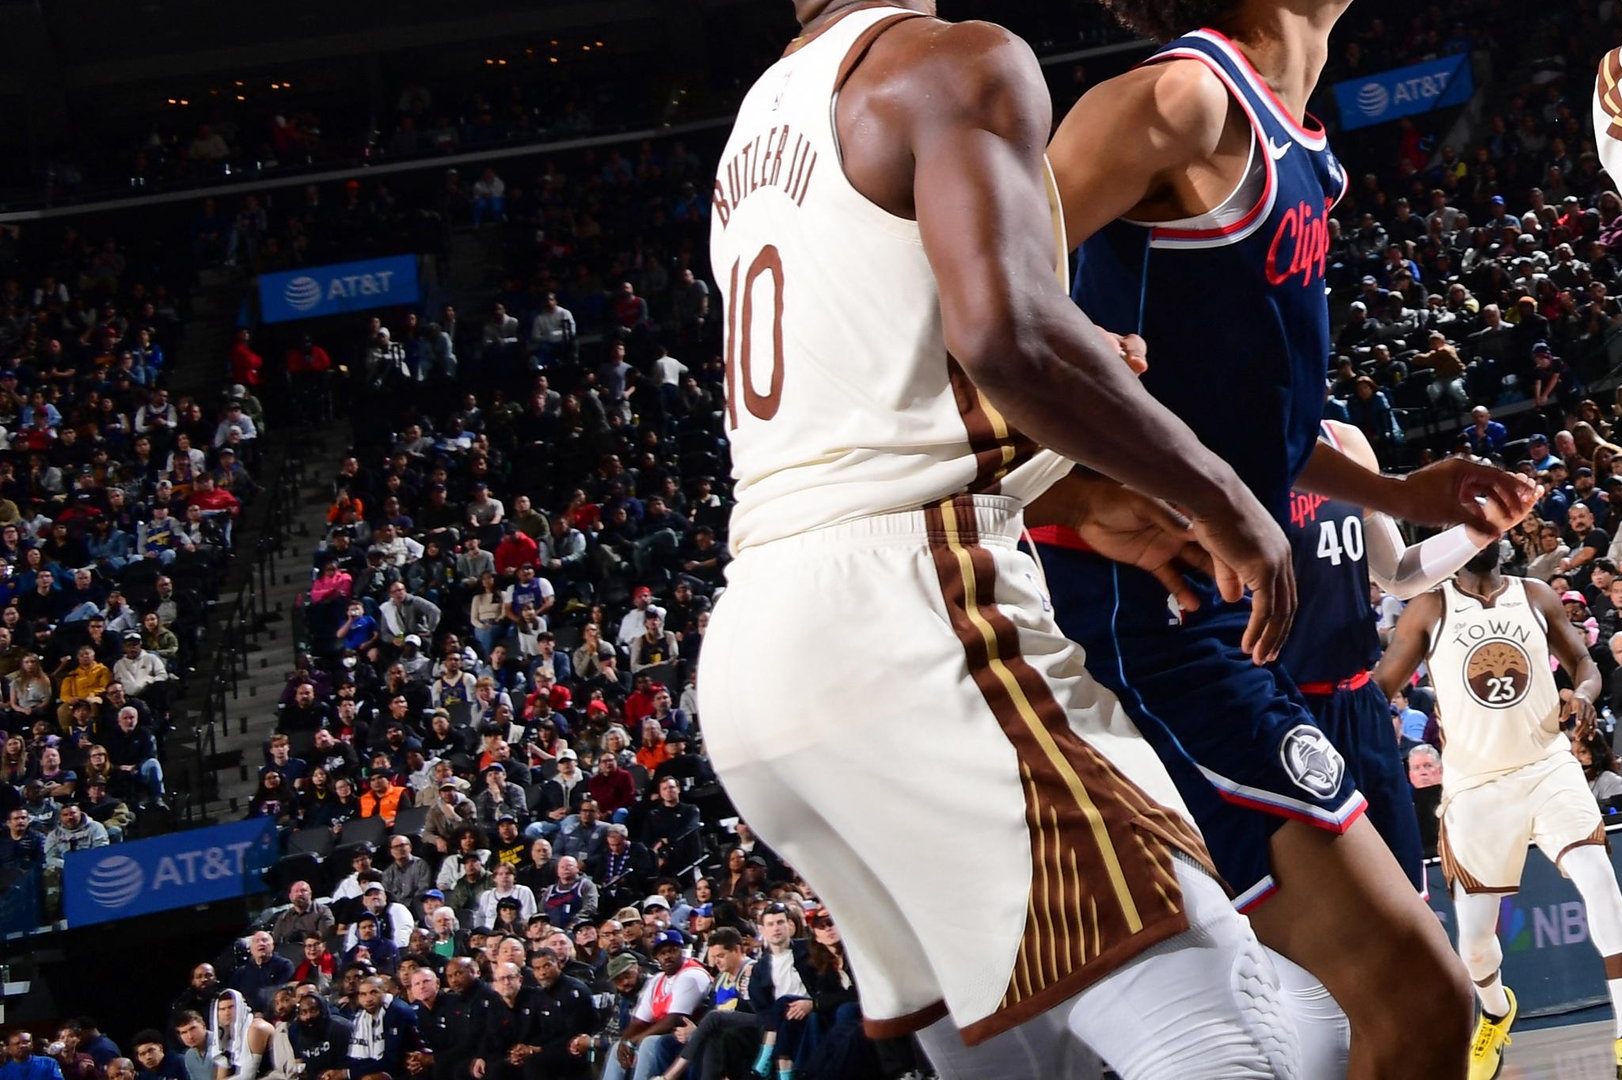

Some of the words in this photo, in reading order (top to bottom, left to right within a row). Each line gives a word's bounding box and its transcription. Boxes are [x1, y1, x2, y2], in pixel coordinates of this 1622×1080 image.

[1393, 69, 1452, 105] AT&T
[713, 123, 790, 232] BUTLER
[326, 270, 394, 302] AT&T
[725, 243, 784, 432] 10
[1317, 515, 1364, 566] 40
[1453, 619, 1531, 648] TOWN
[1486, 676, 1516, 702] 23
[152, 840, 253, 892] AT&T
[1533, 900, 1588, 949] NB
